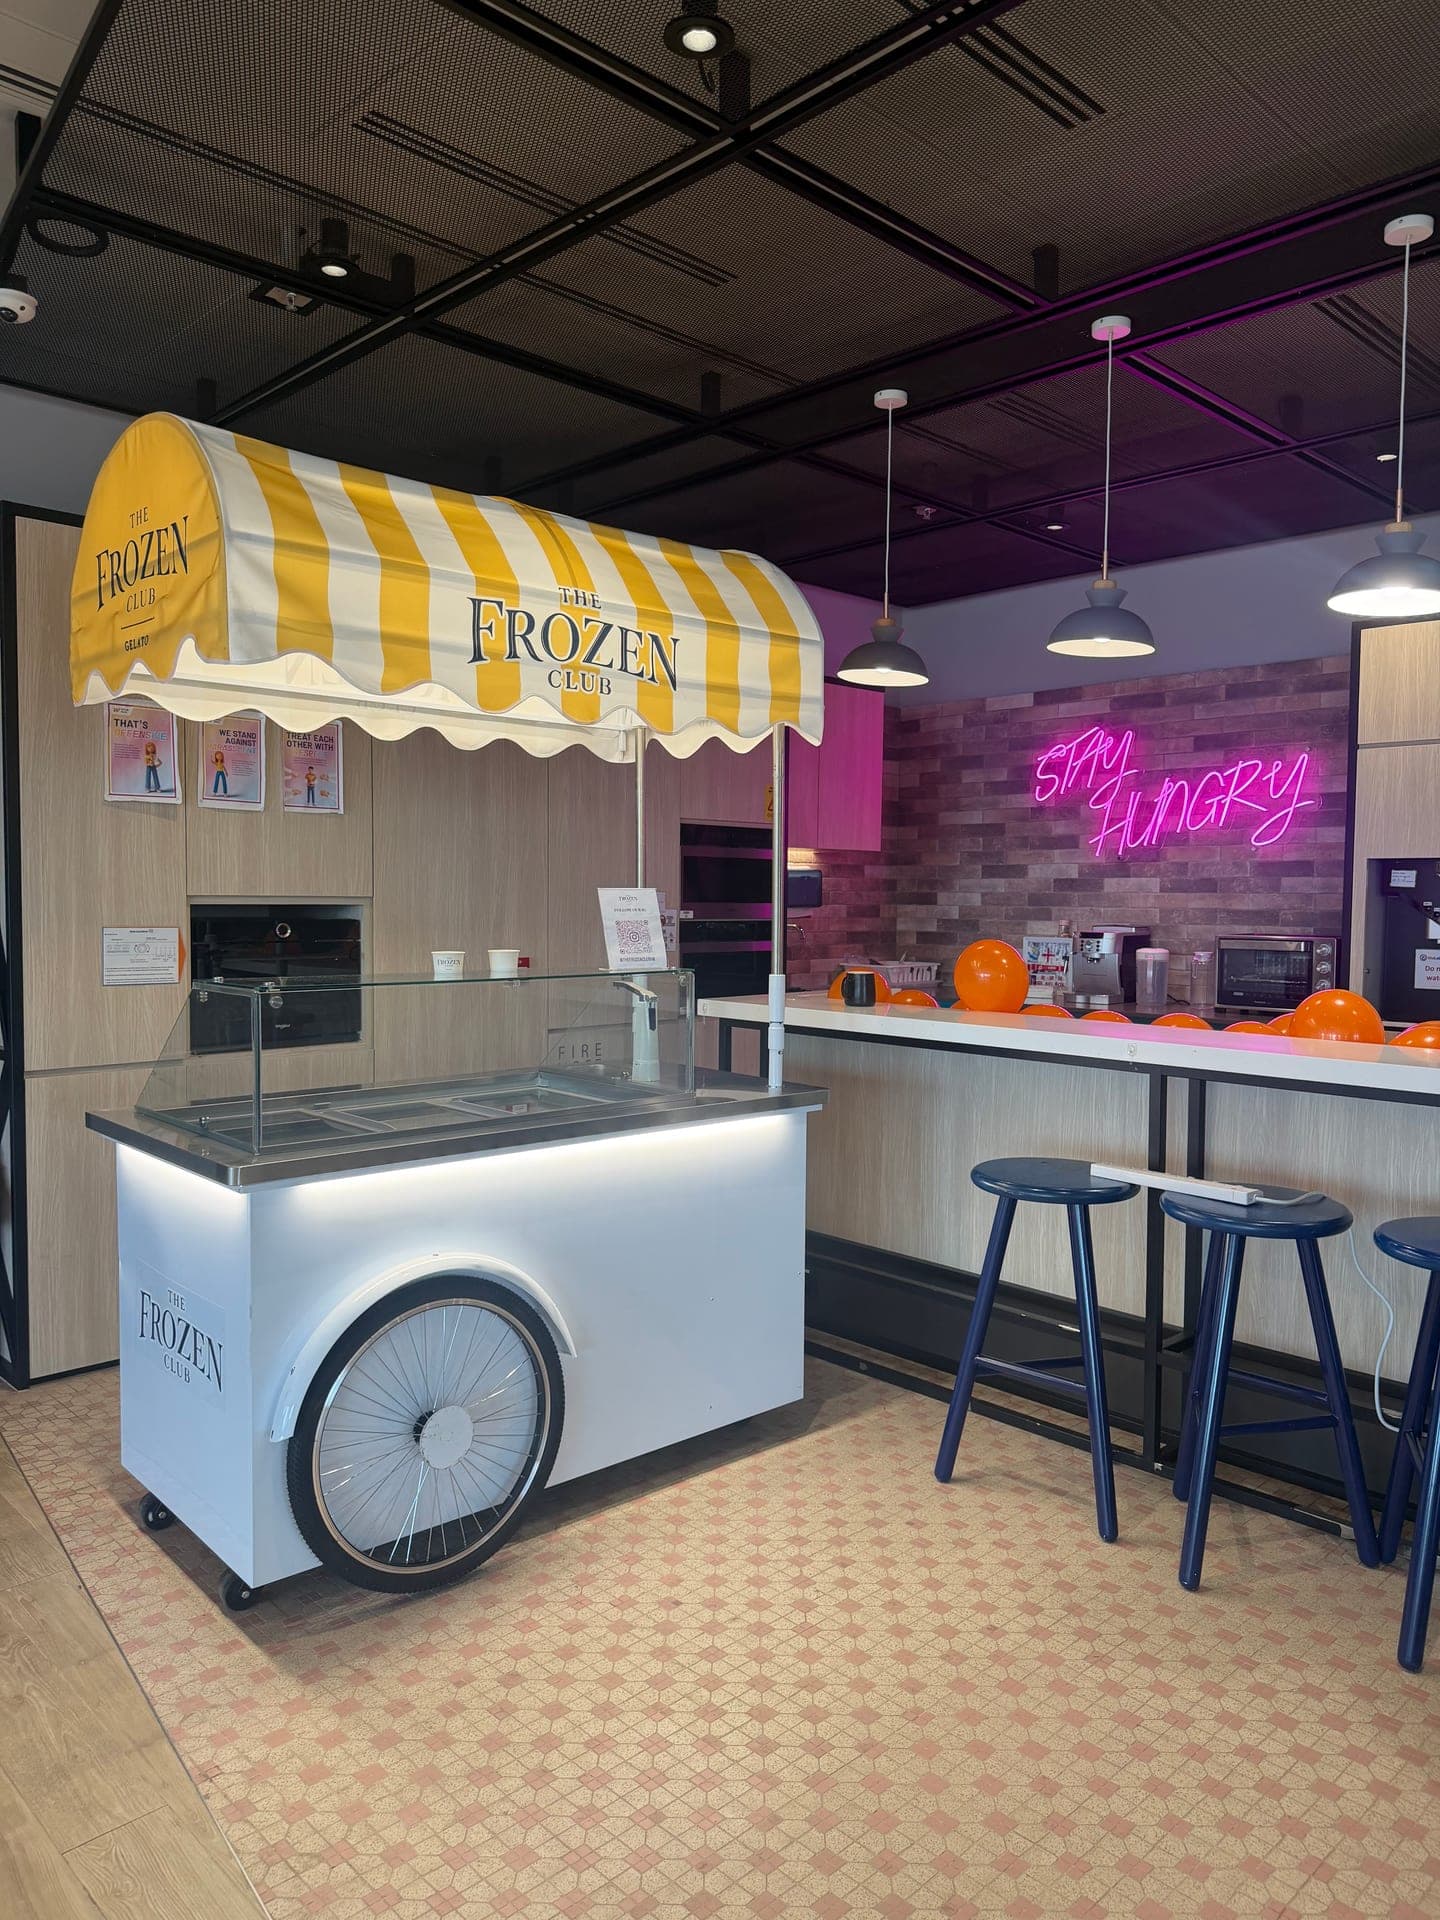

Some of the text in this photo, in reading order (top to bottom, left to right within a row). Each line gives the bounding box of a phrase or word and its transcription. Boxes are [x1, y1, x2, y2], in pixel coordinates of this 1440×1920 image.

[130, 506, 149, 528] THE
[96, 515, 188, 612] FROZEN
[126, 587, 156, 613] CLUB
[558, 586, 602, 609] THE
[124, 634, 150, 651] GELATO
[467, 596, 681, 692] FROZEN
[547, 669, 612, 696] CLUB
[114, 718, 149, 729] THAT'S
[225, 737, 257, 747] AGAINST
[232, 730, 257, 740] STAND
[286, 740, 334, 751] OTHER WITH
[313, 734, 334, 743] EACH
[1035, 726, 1138, 809] STAY
[1089, 753, 1315, 857] HUNGRY
[558, 1042, 602, 1060] FIRE
[168, 1289, 186, 1311] THE
[139, 1290, 223, 1393] FROZEN
[164, 1354, 191, 1384] CLUB
